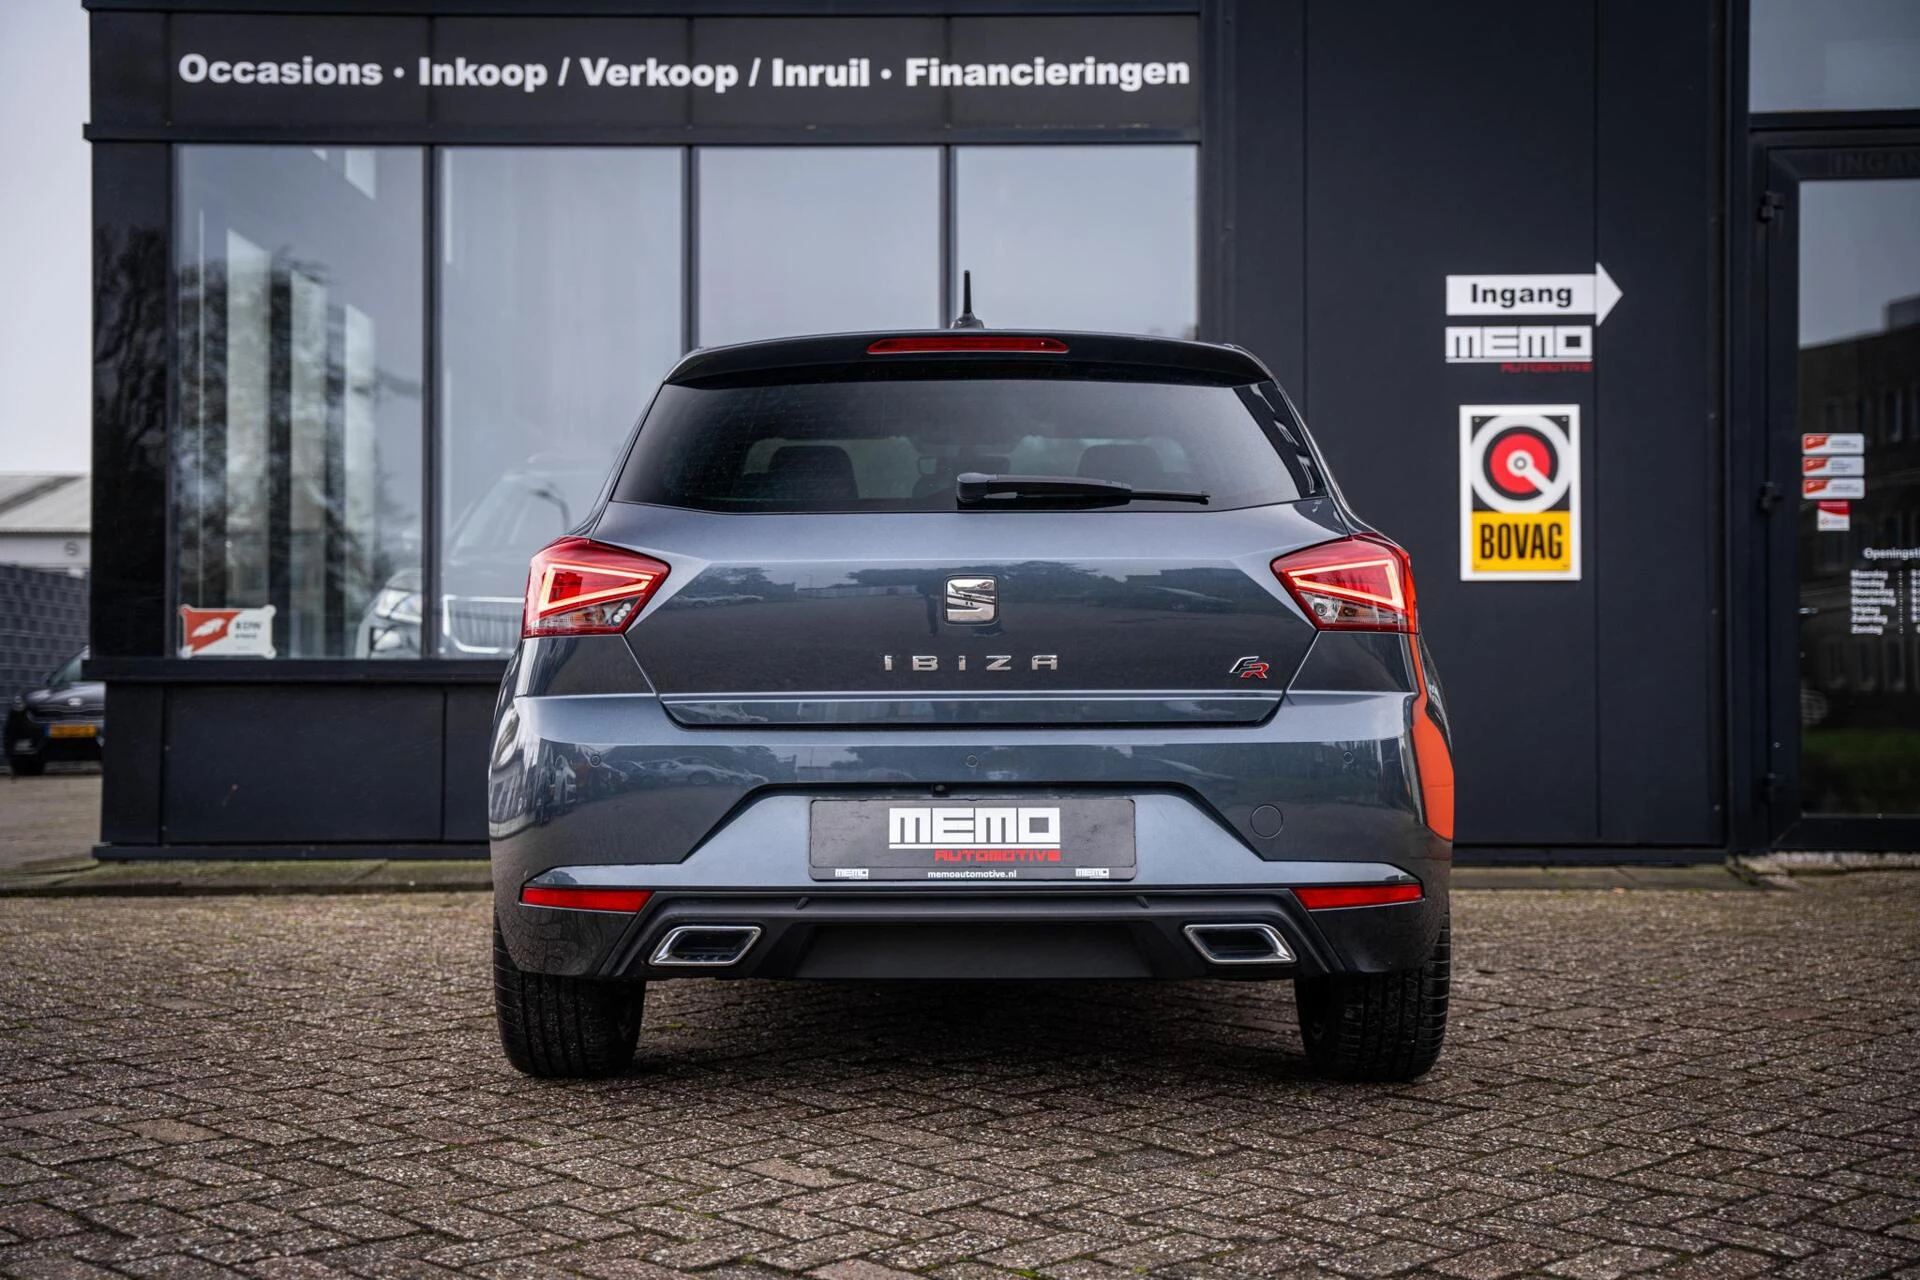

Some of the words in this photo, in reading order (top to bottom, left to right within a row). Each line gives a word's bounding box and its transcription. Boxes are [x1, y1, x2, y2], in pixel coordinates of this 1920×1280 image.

[179, 53, 383, 86] Occasions
[418, 57, 548, 92] Inkoop
[579, 57, 739, 93] Verkoop
[772, 57, 870, 87] Inruil
[906, 56, 1190, 92] Financieringen
[1471, 283, 1572, 308] Ingang
[1446, 326, 1592, 358] MEMO
[1480, 523, 1563, 561] BOVAG
[884, 654, 1058, 671] IBIZA
[1229, 655, 1269, 679] FR
[889, 807, 1060, 843] MEMO
[934, 850, 1061, 862] AUTOMOTIVE
[928, 870, 1017, 878] memoautomotive.nl
